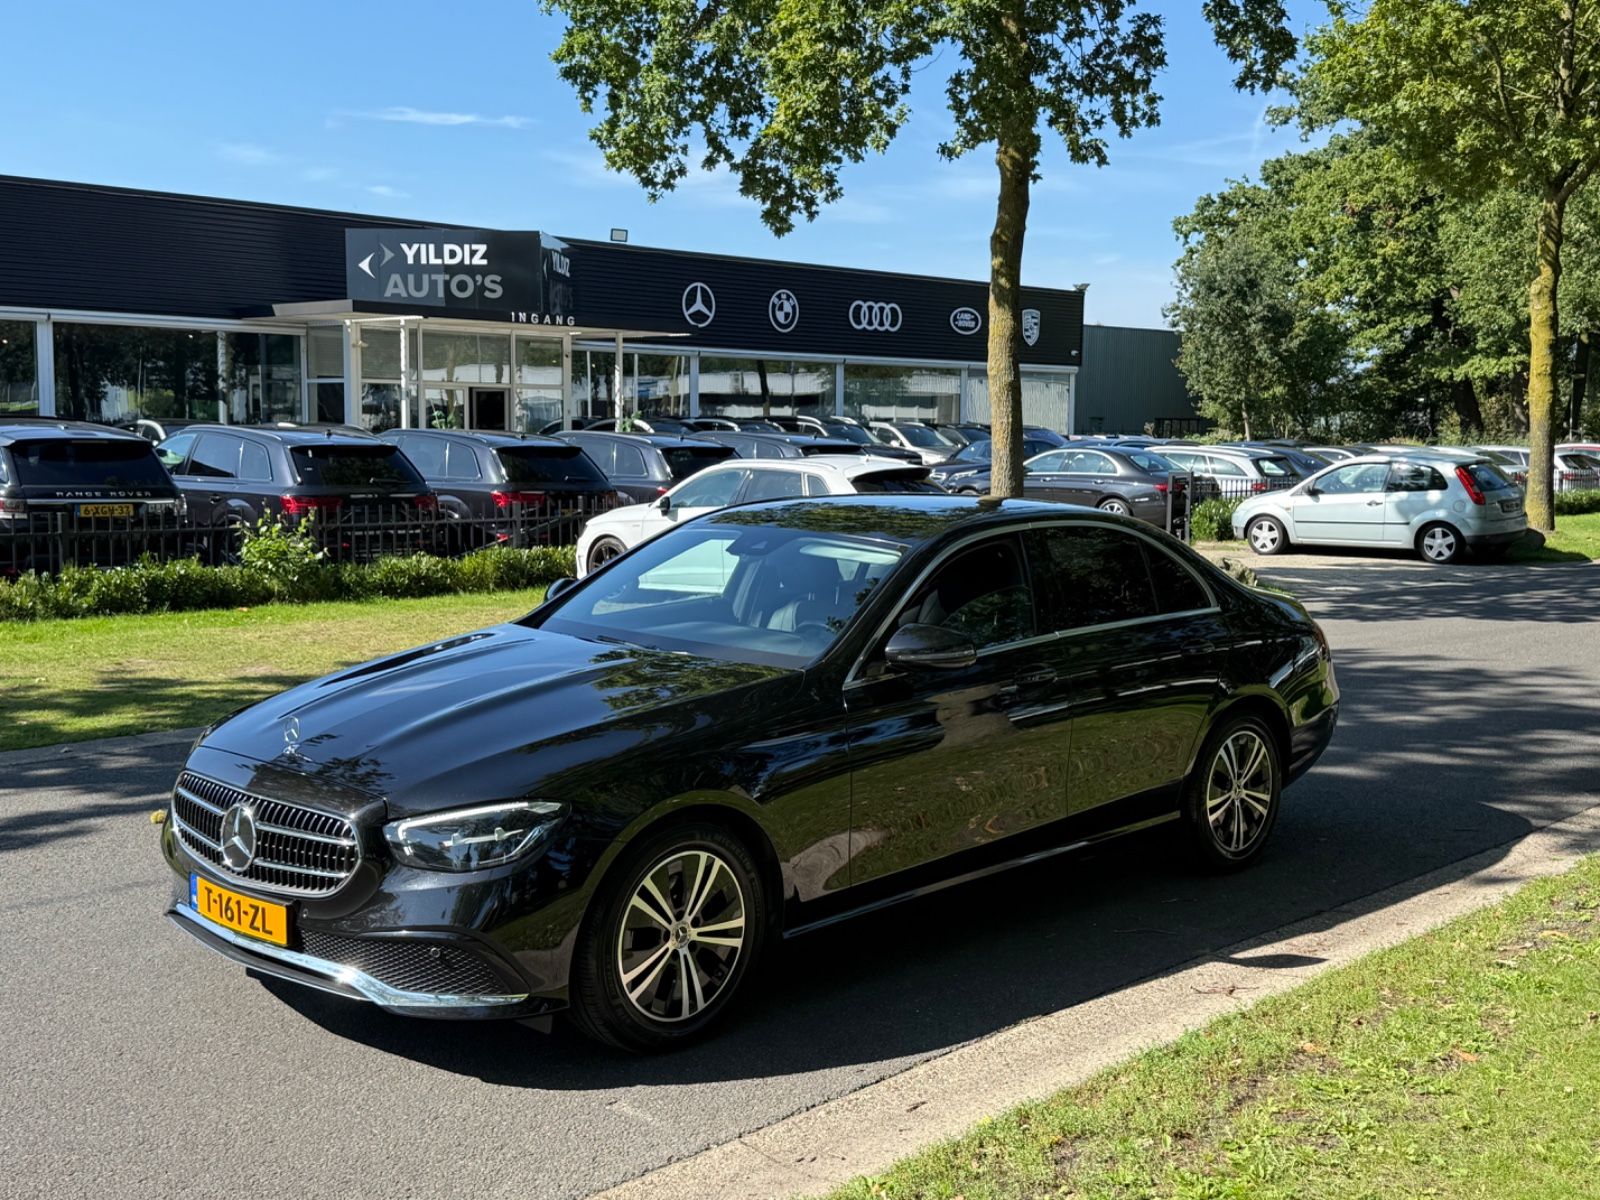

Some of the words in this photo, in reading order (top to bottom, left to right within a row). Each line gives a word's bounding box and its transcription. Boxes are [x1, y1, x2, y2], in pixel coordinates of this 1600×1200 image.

[400, 243, 488, 266] YILDIZ
[383, 273, 504, 299] AUTO'S
[511, 311, 575, 326] INGANG
[204, 886, 273, 936] T-161-ZL
